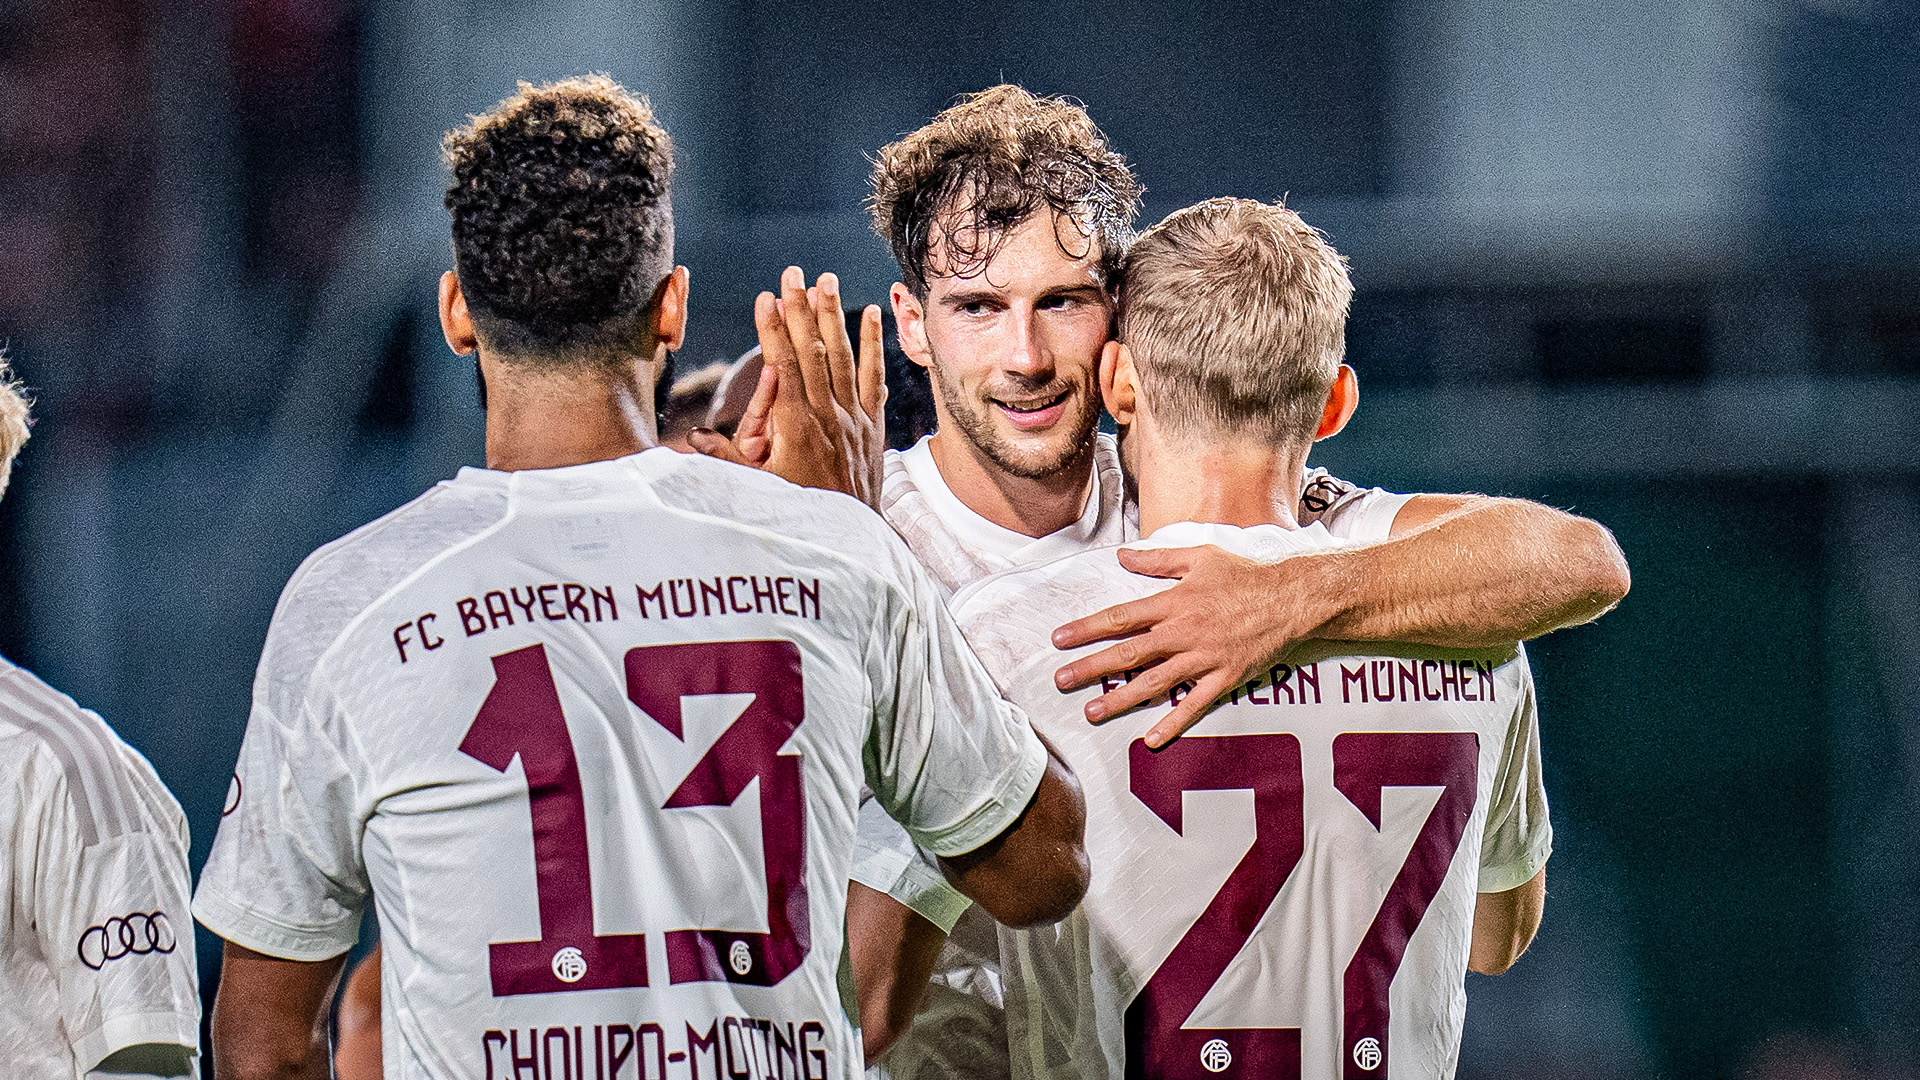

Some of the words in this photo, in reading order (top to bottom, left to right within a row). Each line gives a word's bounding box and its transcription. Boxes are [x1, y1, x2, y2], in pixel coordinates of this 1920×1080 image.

[393, 612, 445, 664] FC
[456, 583, 619, 637] BAYERN
[635, 575, 821, 621] MÜNCHEN
[1339, 658, 1497, 704] MÜNCHEN
[457, 640, 812, 997] 13
[1123, 731, 1481, 1080] 27
[482, 1015, 828, 1080] CHOUPO-MOTING
